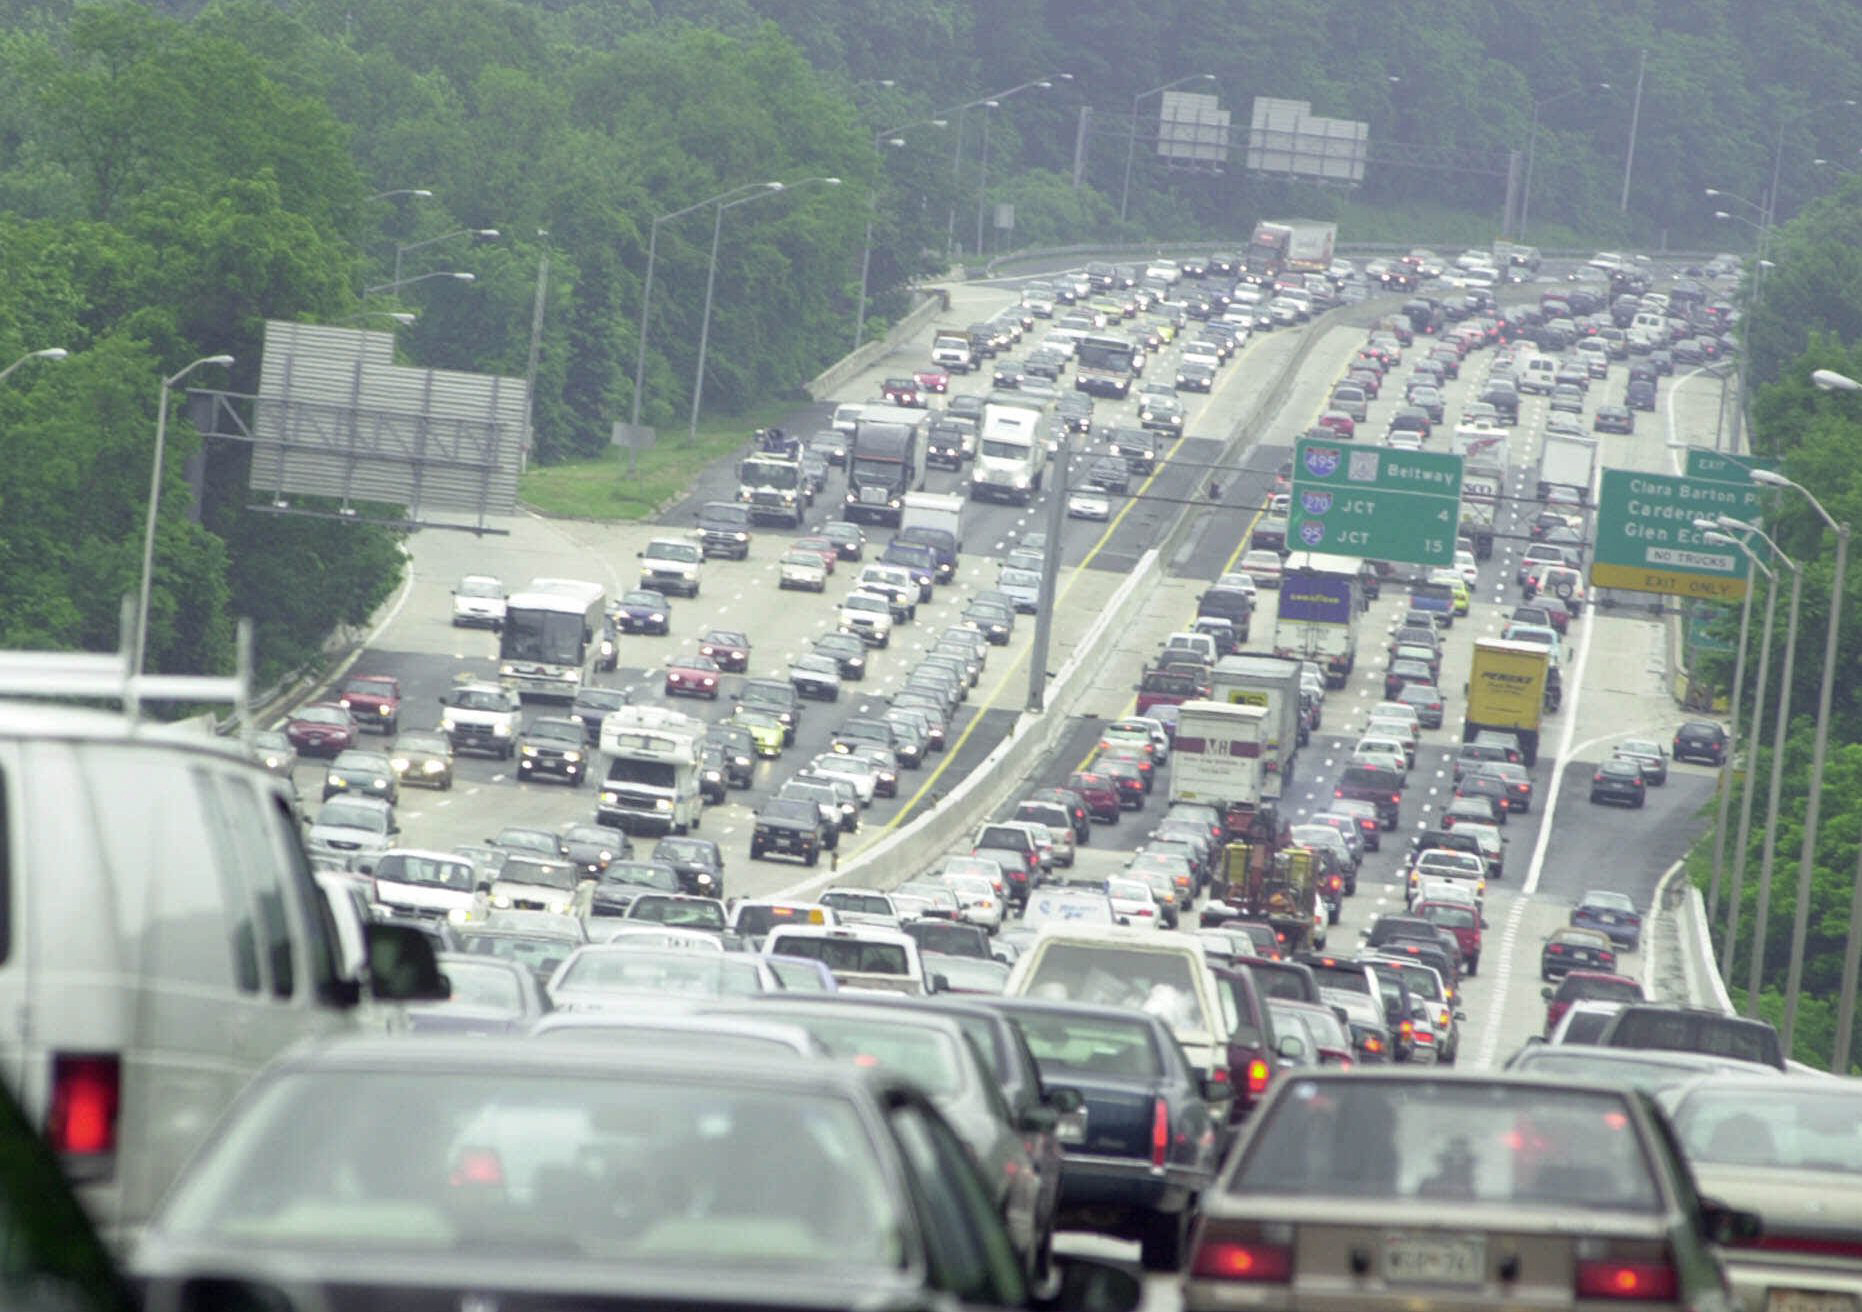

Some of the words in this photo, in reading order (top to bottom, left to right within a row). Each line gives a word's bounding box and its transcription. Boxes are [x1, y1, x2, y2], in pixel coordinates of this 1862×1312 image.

[1307, 455, 1336, 470] 495
[1698, 458, 1727, 470] EXIT
[1387, 463, 1455, 486] Beltway
[1629, 479, 1672, 496] Clara
[1679, 484, 1736, 504] Barton
[1305, 495, 1328, 510] 270
[1341, 501, 1375, 515] JCT
[1437, 510, 1449, 522] 4
[1627, 500, 1727, 522] Carderoc
[1302, 527, 1321, 539] 95
[1337, 530, 1369, 544] JCT
[1424, 539, 1443, 552] 15
[1624, 522, 1668, 541] Glen
[1653, 550, 1671, 562] NO
[1678, 554, 1727, 568] TRUCKS
[1645, 575, 1676, 589] EXIT
[1689, 581, 1730, 595] ONLY
